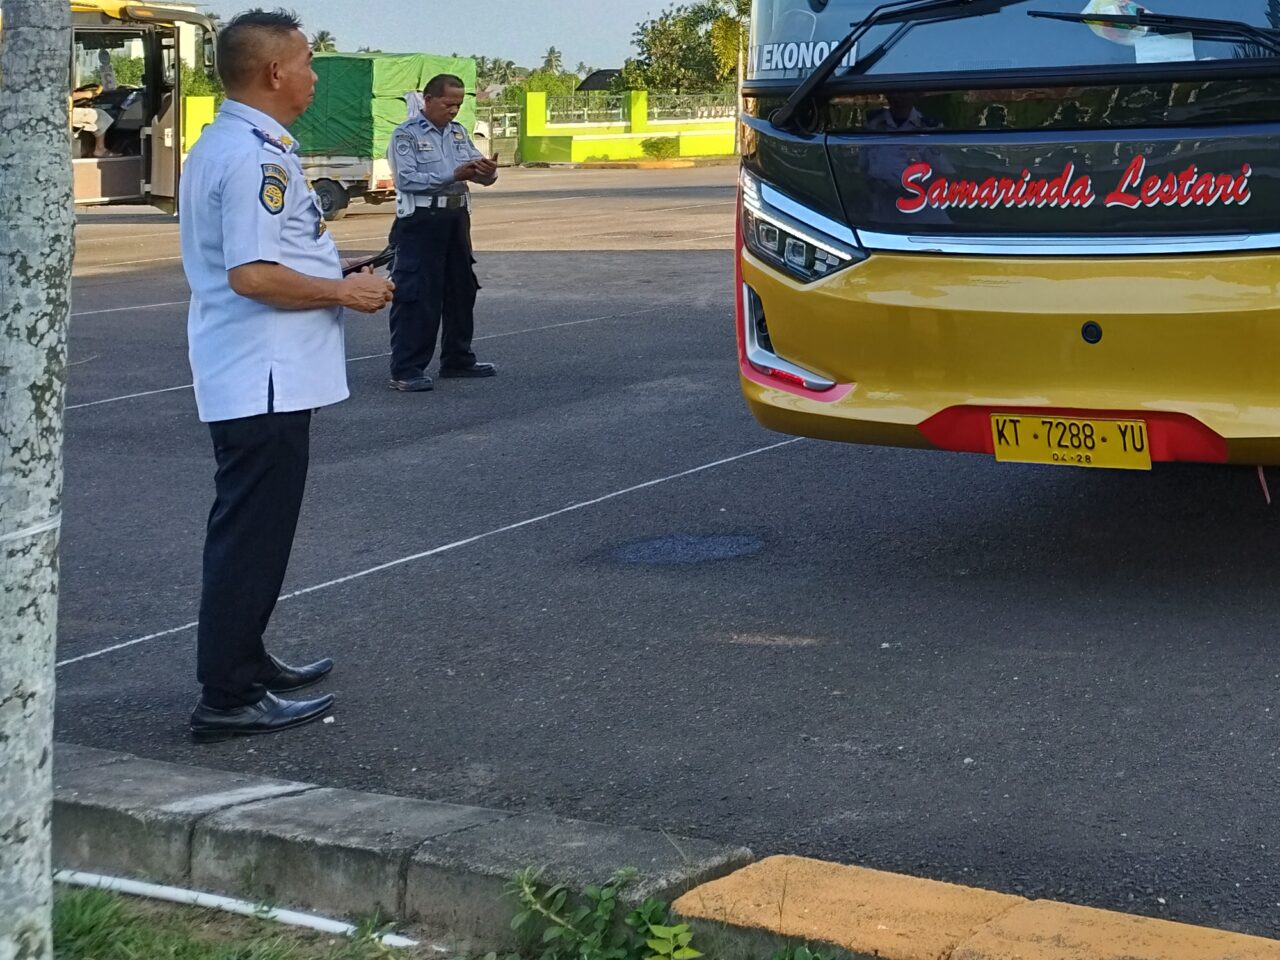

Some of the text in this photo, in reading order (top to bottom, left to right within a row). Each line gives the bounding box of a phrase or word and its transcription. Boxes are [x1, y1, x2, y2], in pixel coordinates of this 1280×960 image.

[896, 153, 1252, 213] Samarinda Lestari
[995, 418, 1146, 453] KT 7288 YU
